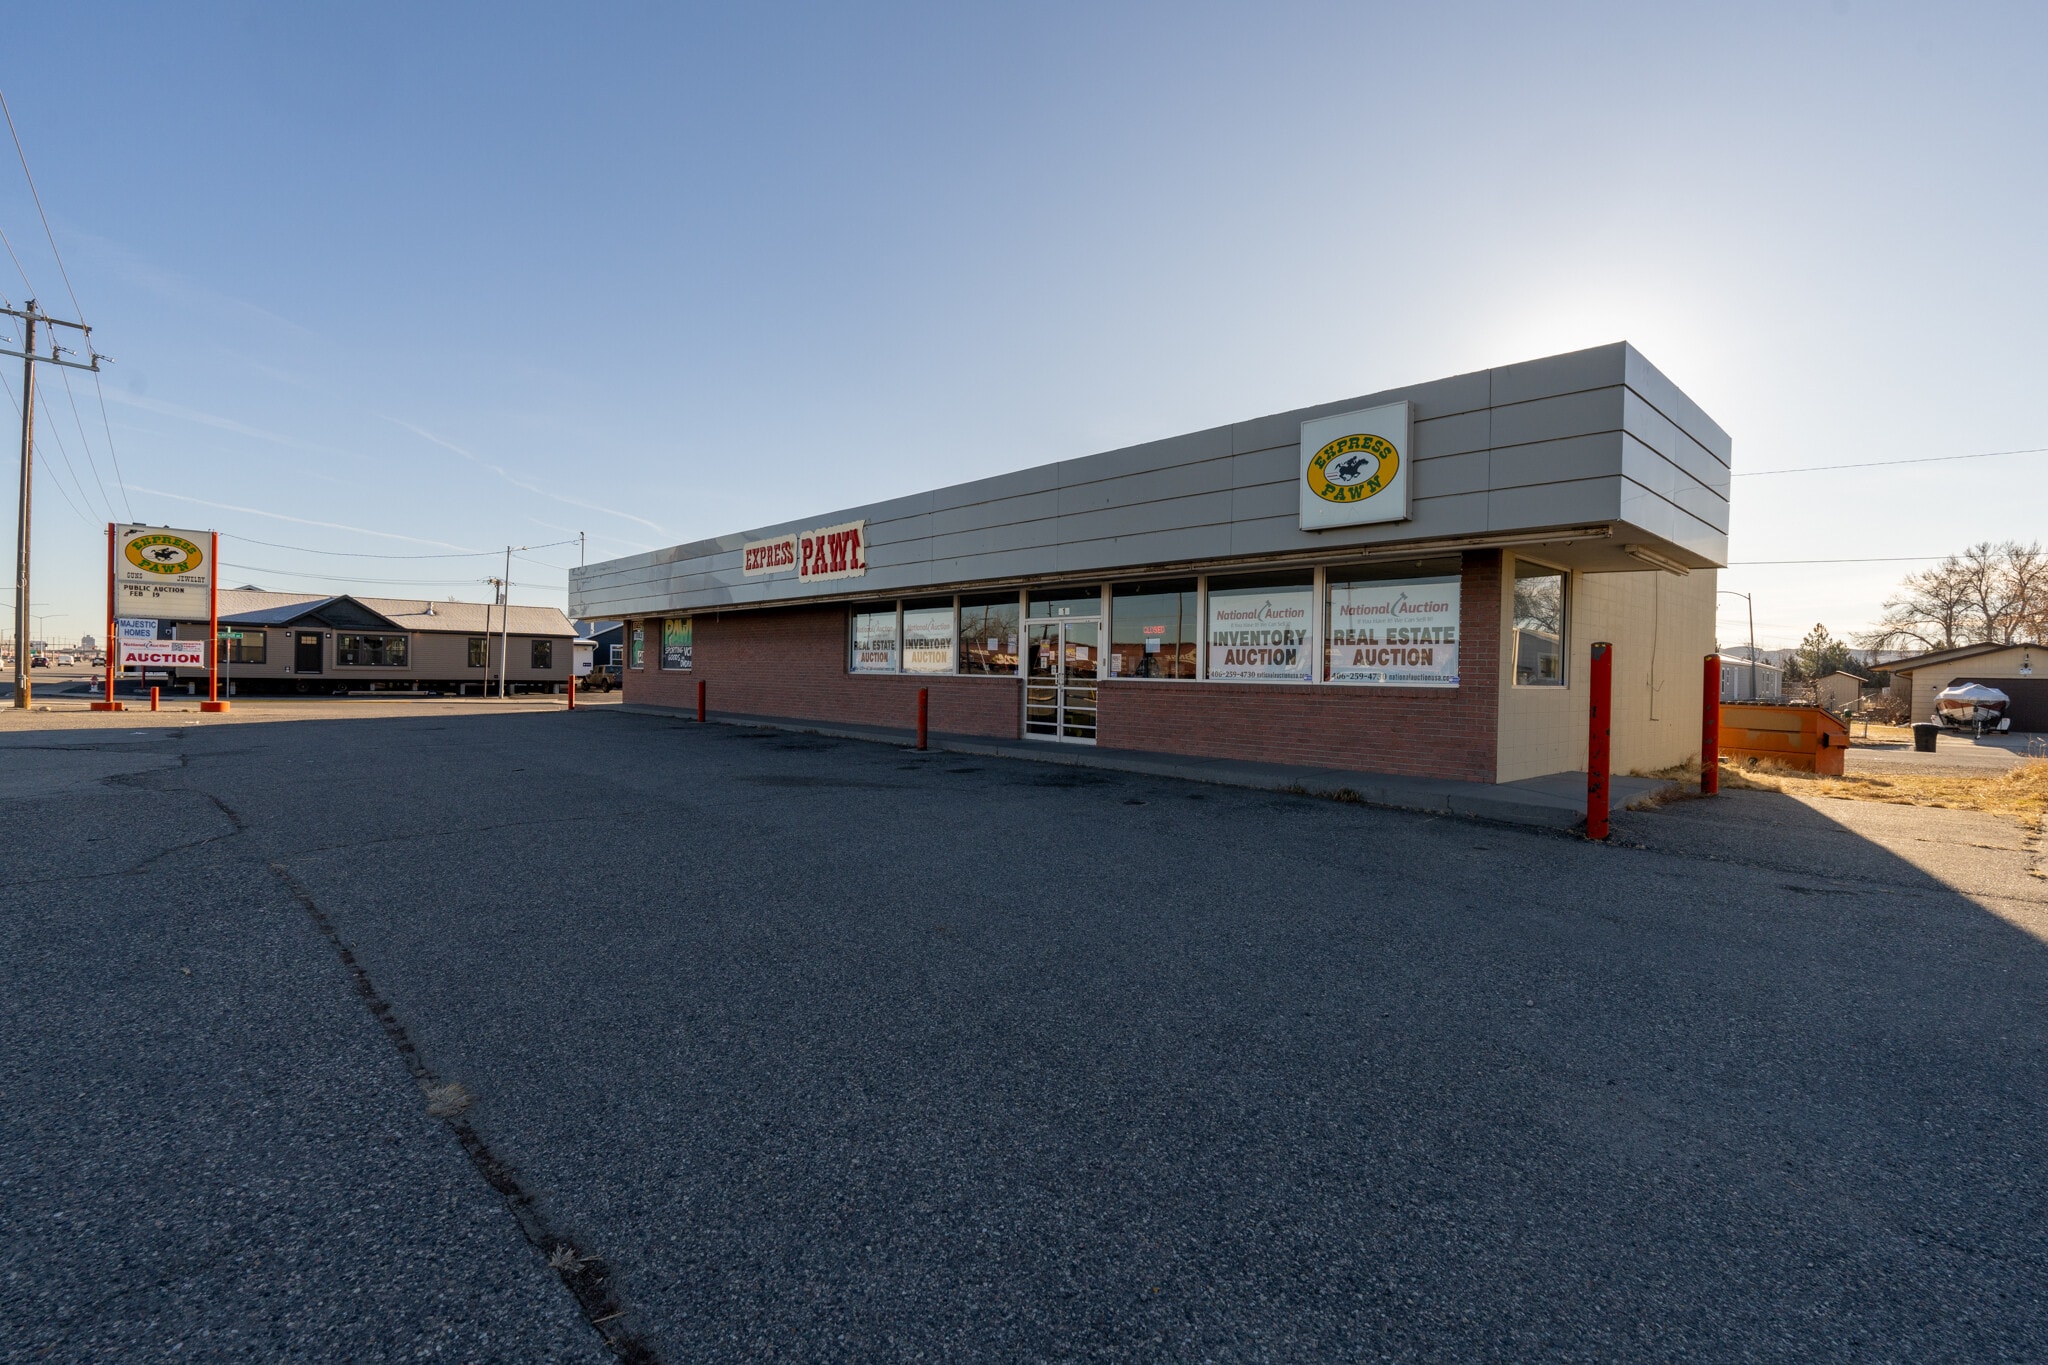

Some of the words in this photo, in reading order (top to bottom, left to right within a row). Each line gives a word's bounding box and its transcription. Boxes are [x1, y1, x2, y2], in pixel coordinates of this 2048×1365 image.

[1314, 437, 1392, 470] EXPRESS
[1322, 475, 1382, 500] PAWN
[132, 536, 196, 554] EXPRESS
[746, 541, 794, 570] EXPRESS
[138, 560, 188, 572] PAWN
[1217, 609, 1257, 620] National
[1265, 608, 1304, 619] Auction
[1340, 602, 1390, 616] National
[1398, 602, 1449, 614] Auction
[120, 619, 156, 628] MAJESTIC
[1143, 626, 1165, 634] CLOSED
[1213, 629, 1307, 646] INVENTORY
[1334, 628, 1378, 646] REAL
[1386, 626, 1455, 644] ESTATE
[854, 641, 870, 650] REAL
[873, 640, 895, 650] ESTATE
[906, 638, 951, 650] INVENTORY
[125, 653, 200, 663] AUCTION
[861, 652, 888, 662] AUCTION
[912, 652, 947, 663] AUCTION
[1224, 649, 1296, 665] AUCTION
[1353, 648, 1433, 666] AUCTION
